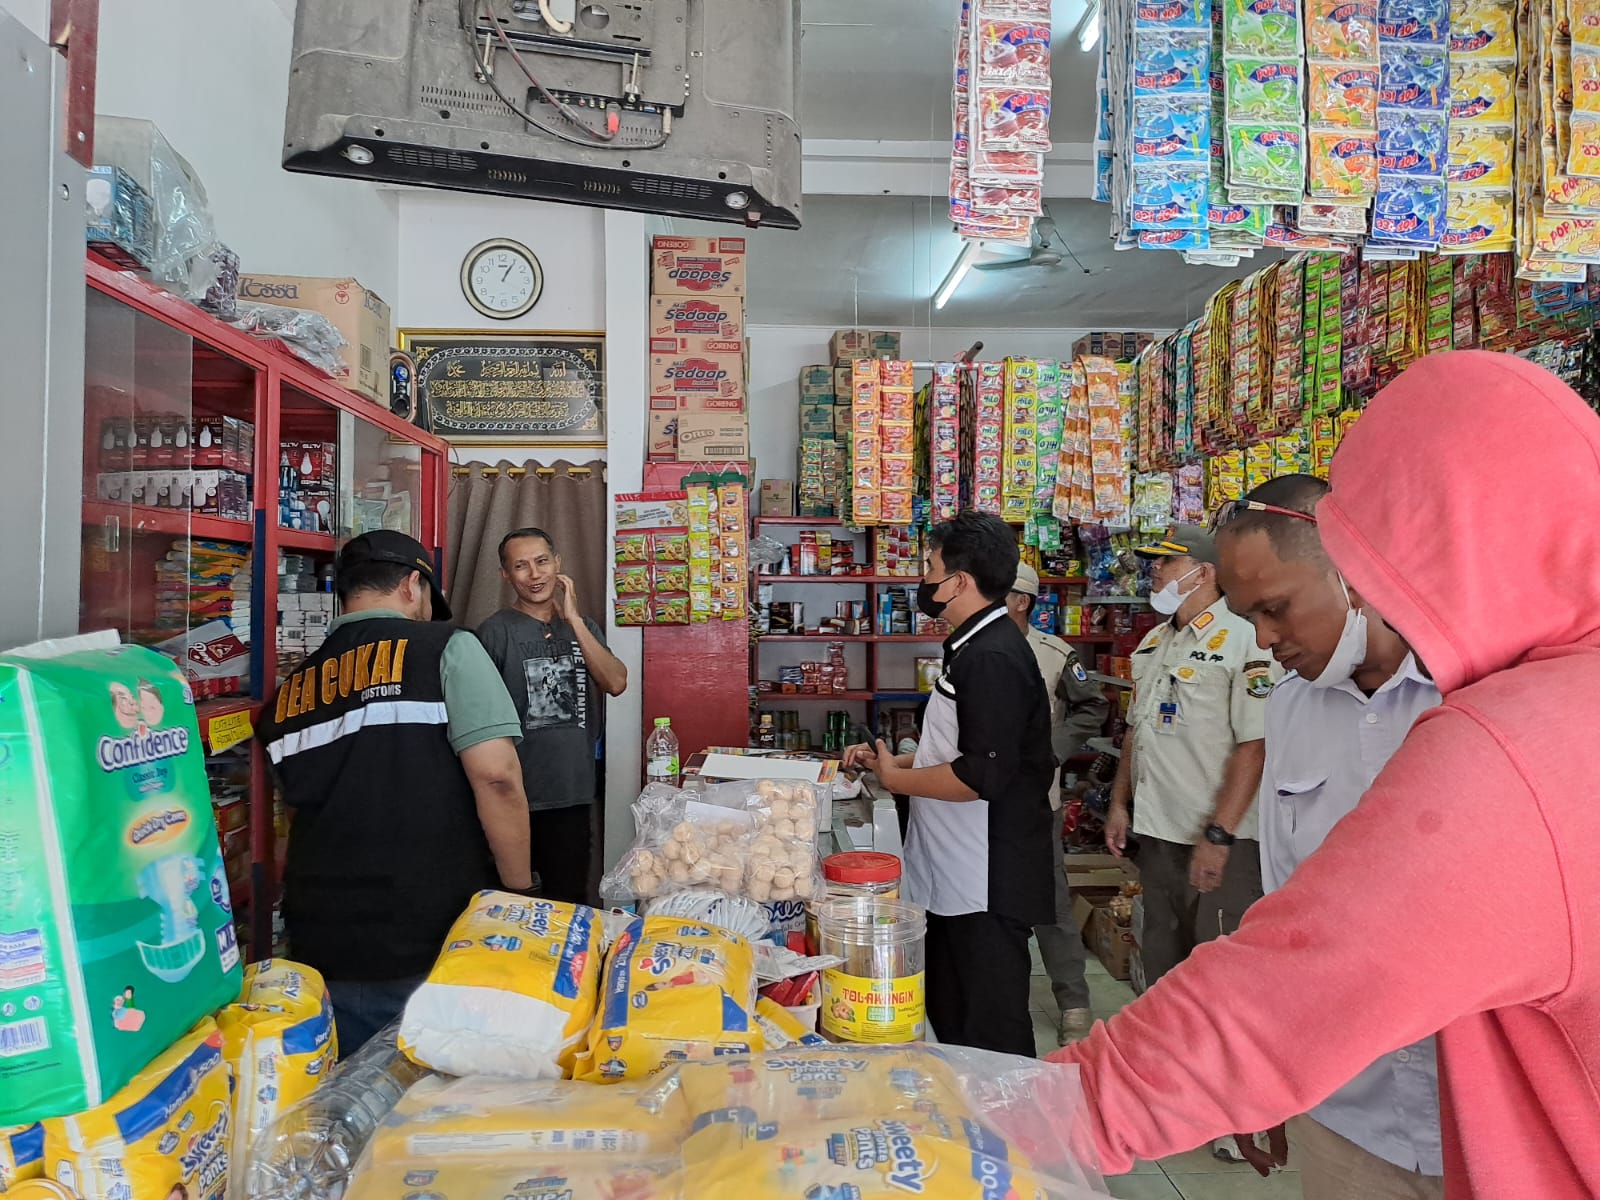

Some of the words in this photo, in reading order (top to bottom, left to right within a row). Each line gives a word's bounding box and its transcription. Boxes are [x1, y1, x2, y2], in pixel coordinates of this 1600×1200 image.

[664, 309, 728, 323] Sedaap
[664, 367, 727, 381] Sedaap
[706, 400, 738, 408] GORENG
[680, 430, 714, 442] OREO
[571, 641, 585, 665] THE
[1190, 650, 1207, 662] POL
[1209, 653, 1225, 663] PP
[321, 639, 408, 706] CUKAI
[361, 684, 402, 702] CUSTOMS
[575, 668, 587, 729] INFINITY
[760, 734, 775, 743] ABC
[99, 727, 189, 768] Confidence
[766, 1058, 869, 1073] Sweety
[788, 1071, 848, 1083] Pants
[857, 1127, 875, 1170] Pants
